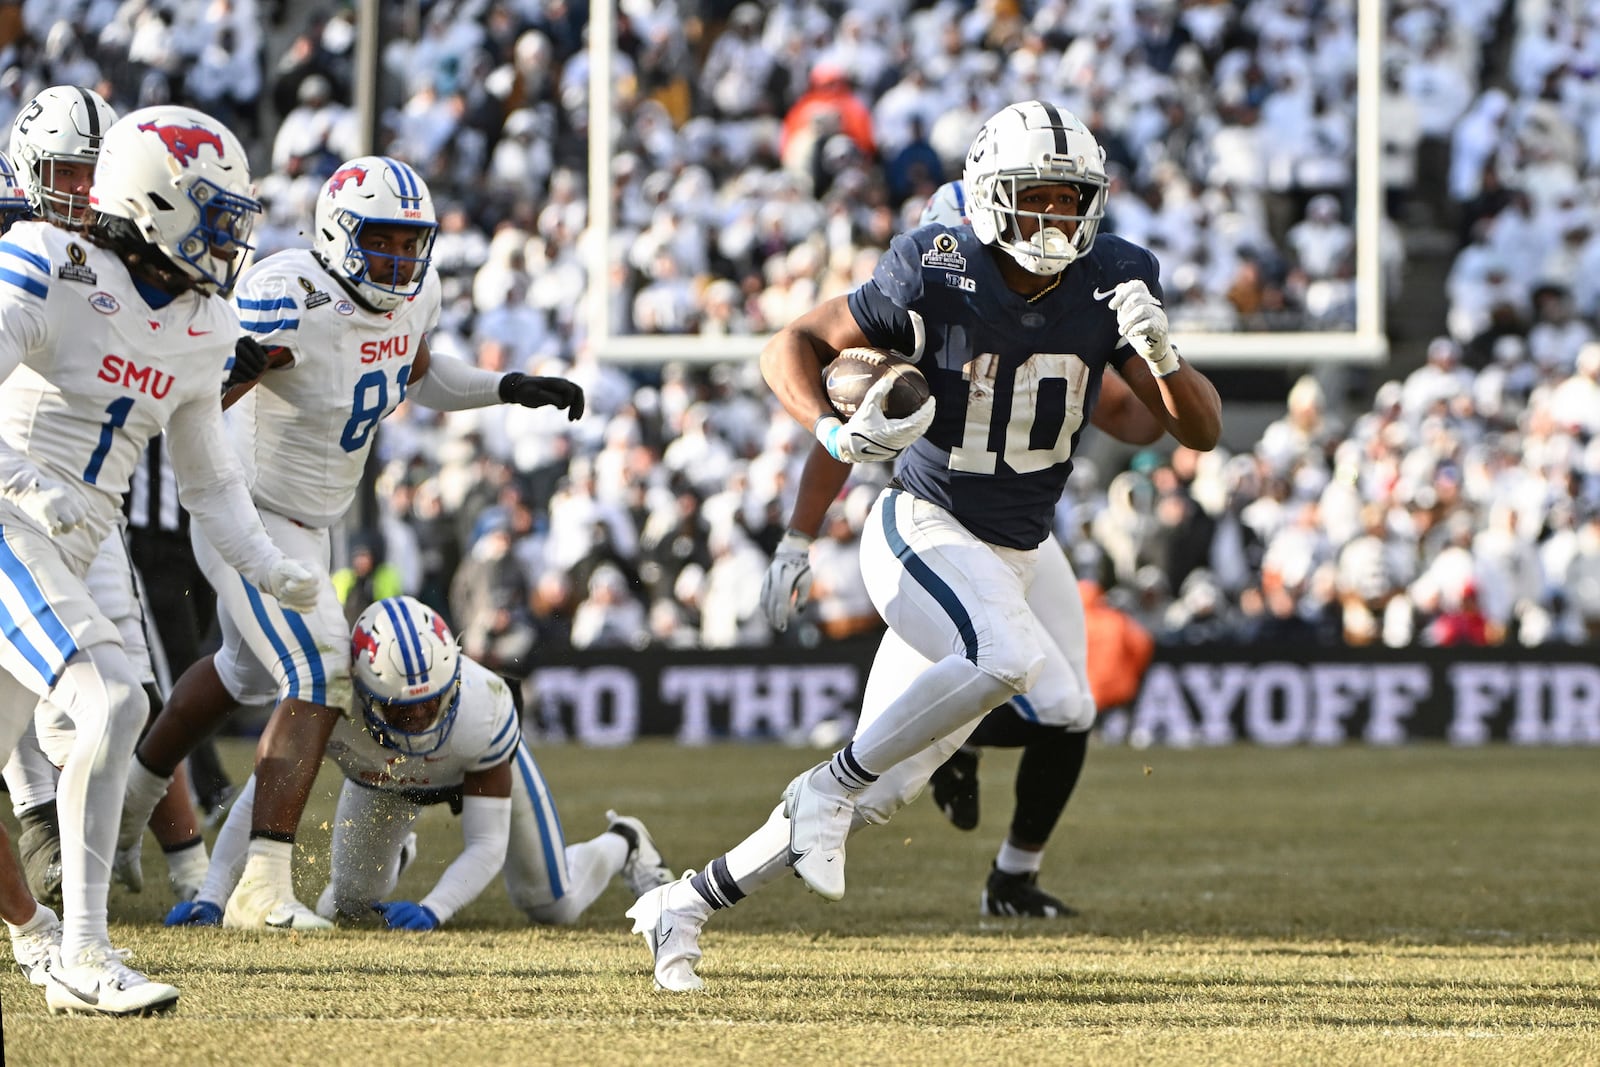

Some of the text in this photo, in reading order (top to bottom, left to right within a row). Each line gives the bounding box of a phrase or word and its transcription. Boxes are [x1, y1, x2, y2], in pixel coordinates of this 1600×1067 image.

[404, 210, 421, 219] SMU
[360, 335, 408, 364] SMU
[97, 354, 175, 400] SMU
[948, 353, 1090, 475] 10
[83, 396, 135, 485] 1
[409, 685, 430, 697] SMU
[530, 661, 1600, 747] TO THE AYOFF FIR
